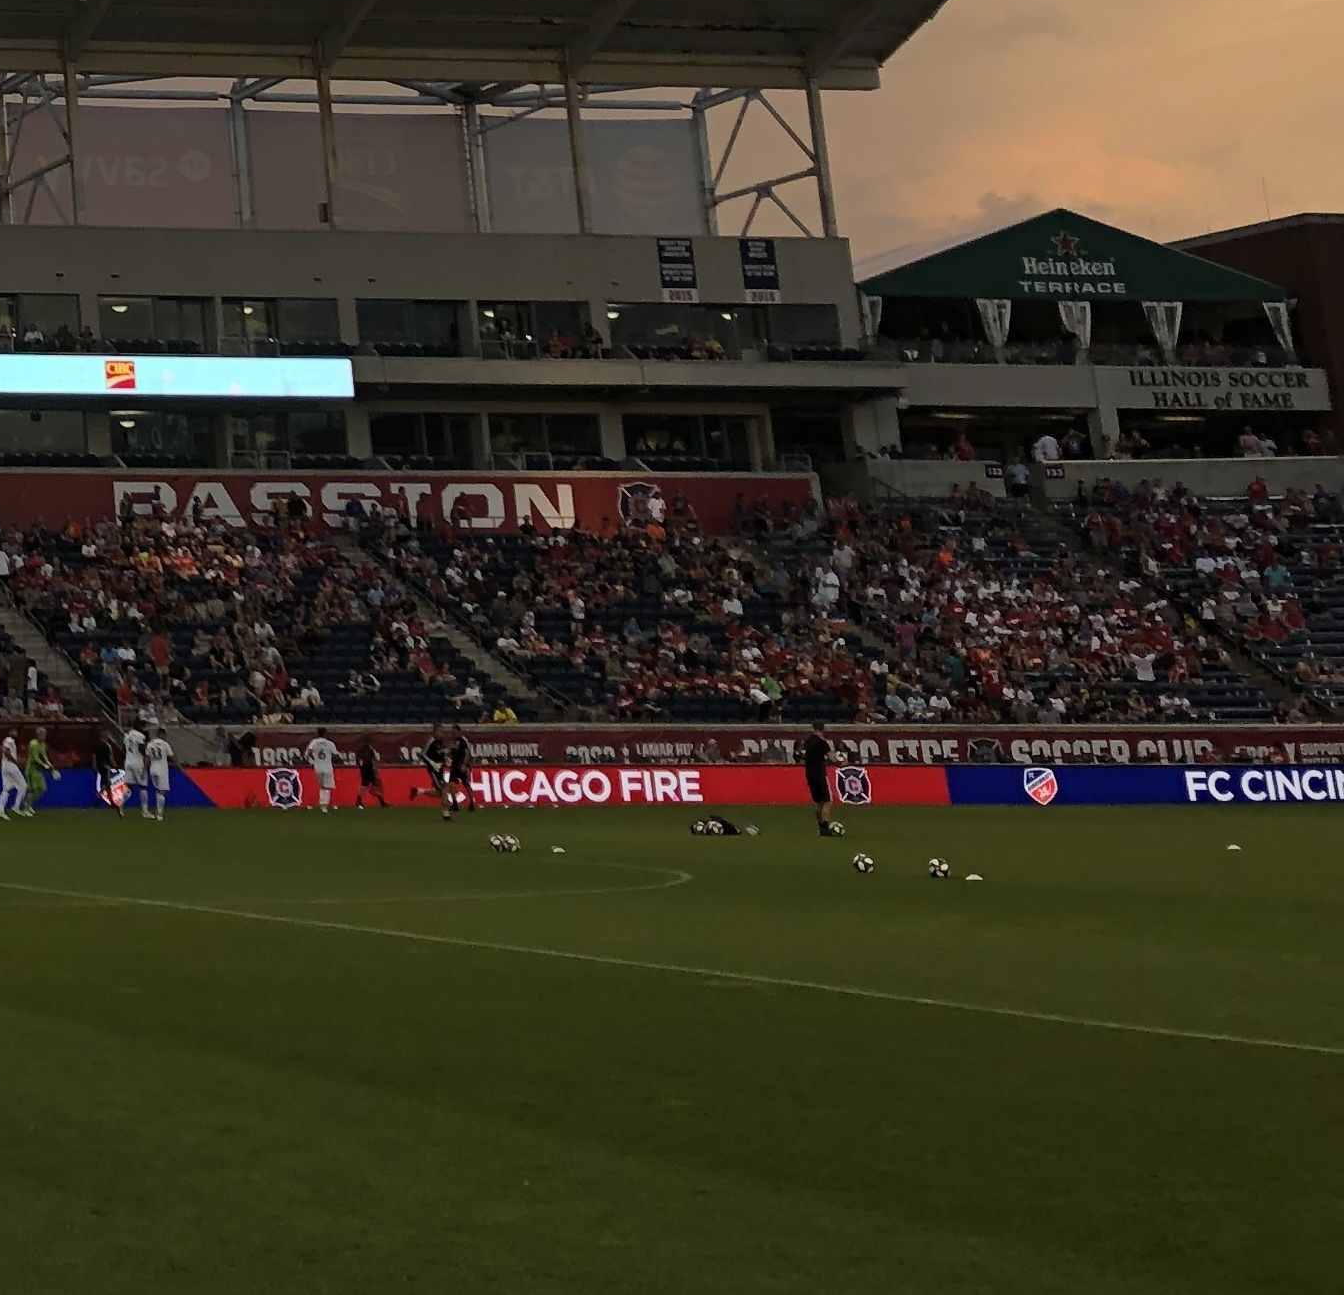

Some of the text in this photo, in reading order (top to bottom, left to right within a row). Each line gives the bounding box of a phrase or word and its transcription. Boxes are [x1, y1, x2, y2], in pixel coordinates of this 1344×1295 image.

[1022, 256, 1115, 276] Heineken
[1017, 280, 1127, 295] TERRACE
[1128, 370, 1310, 388] ILLINOIS SOCCER
[1152, 391, 1295, 408] HALL of FAME
[112, 481, 576, 529] PASSION
[887, 739, 960, 764] FIRE
[1010, 739, 1130, 764] SOCCER
[618, 769, 704, 803] FIRE
[1184, 769, 1235, 802] FC
